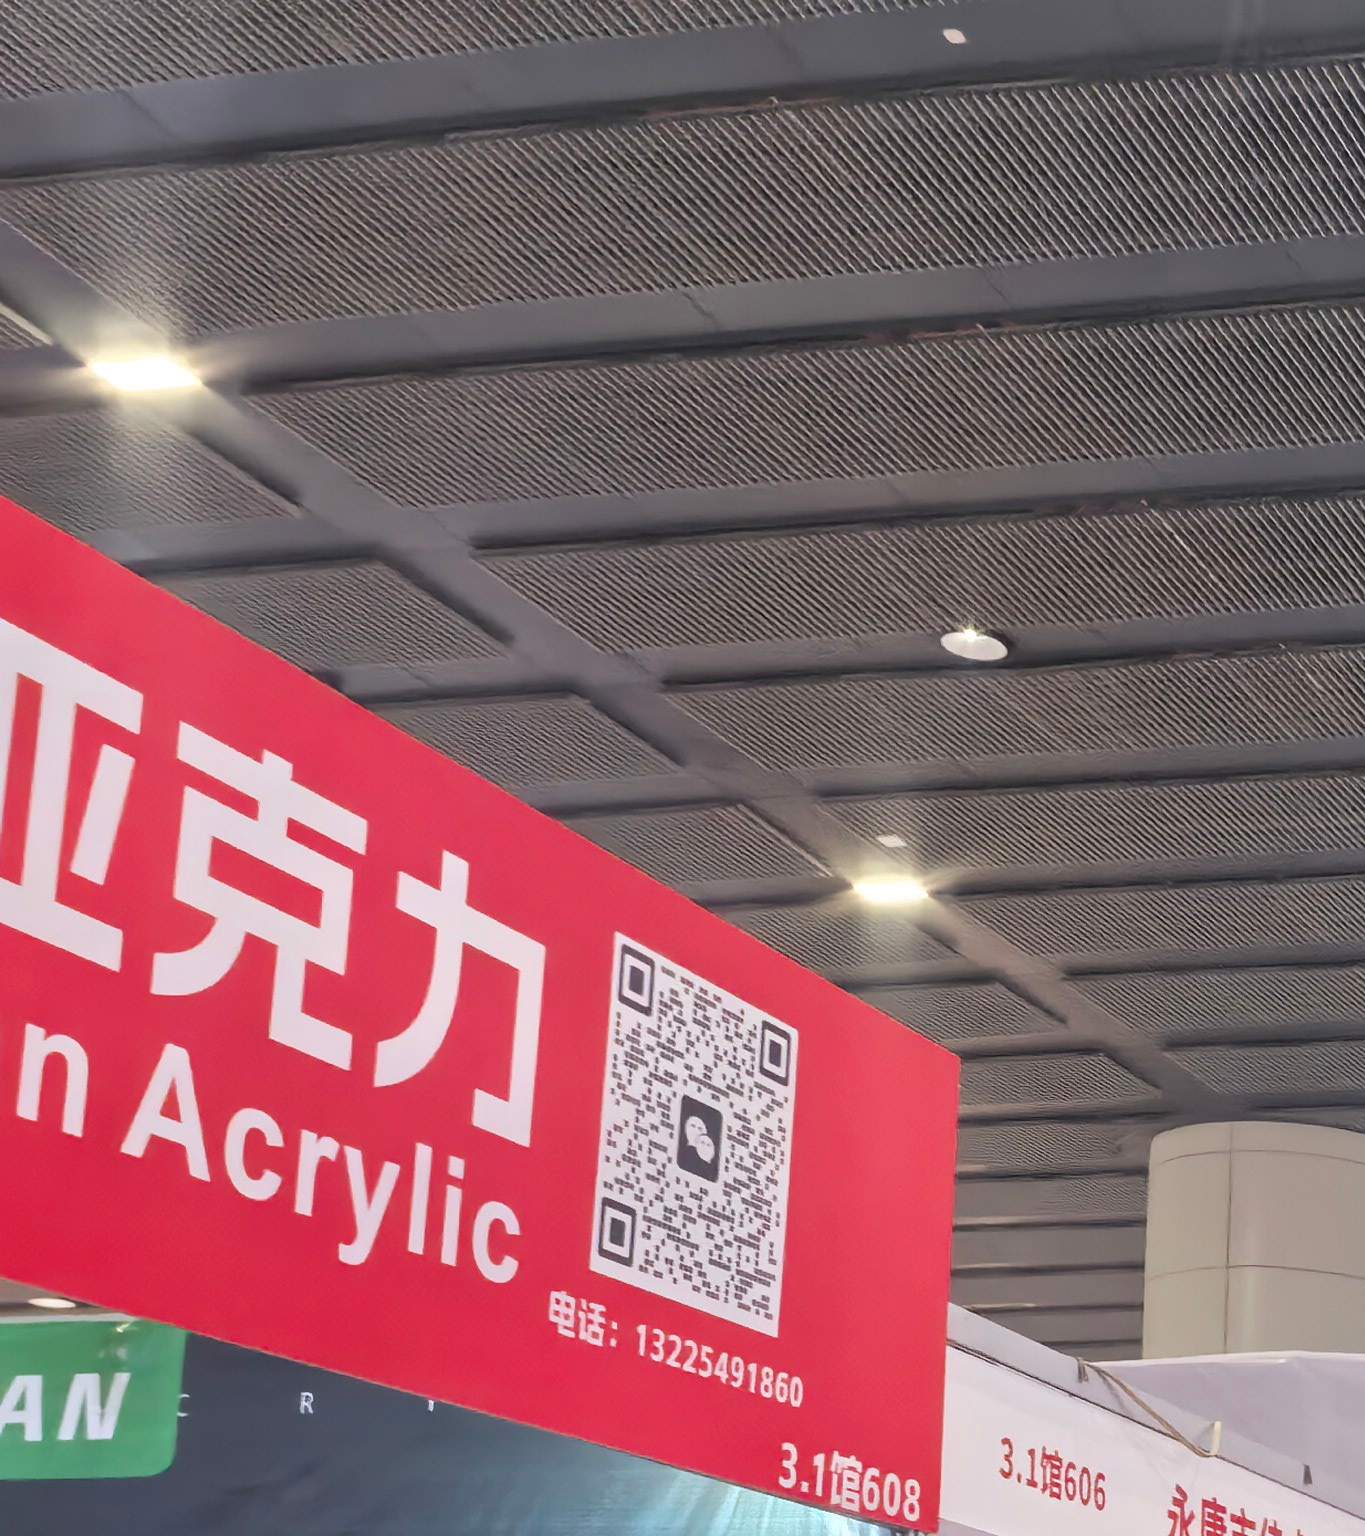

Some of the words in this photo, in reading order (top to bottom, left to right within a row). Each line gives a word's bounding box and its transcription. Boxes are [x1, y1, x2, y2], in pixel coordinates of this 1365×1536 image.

[0, 617, 546, 1147] 亚克力
[121, 1042, 522, 1284] Acrylic
[635, 1321, 804, 1409] 13225491860
[777, 1442, 922, 1521] 3.1馆608
[1000, 1437, 1107, 1511] 3.1馆606
